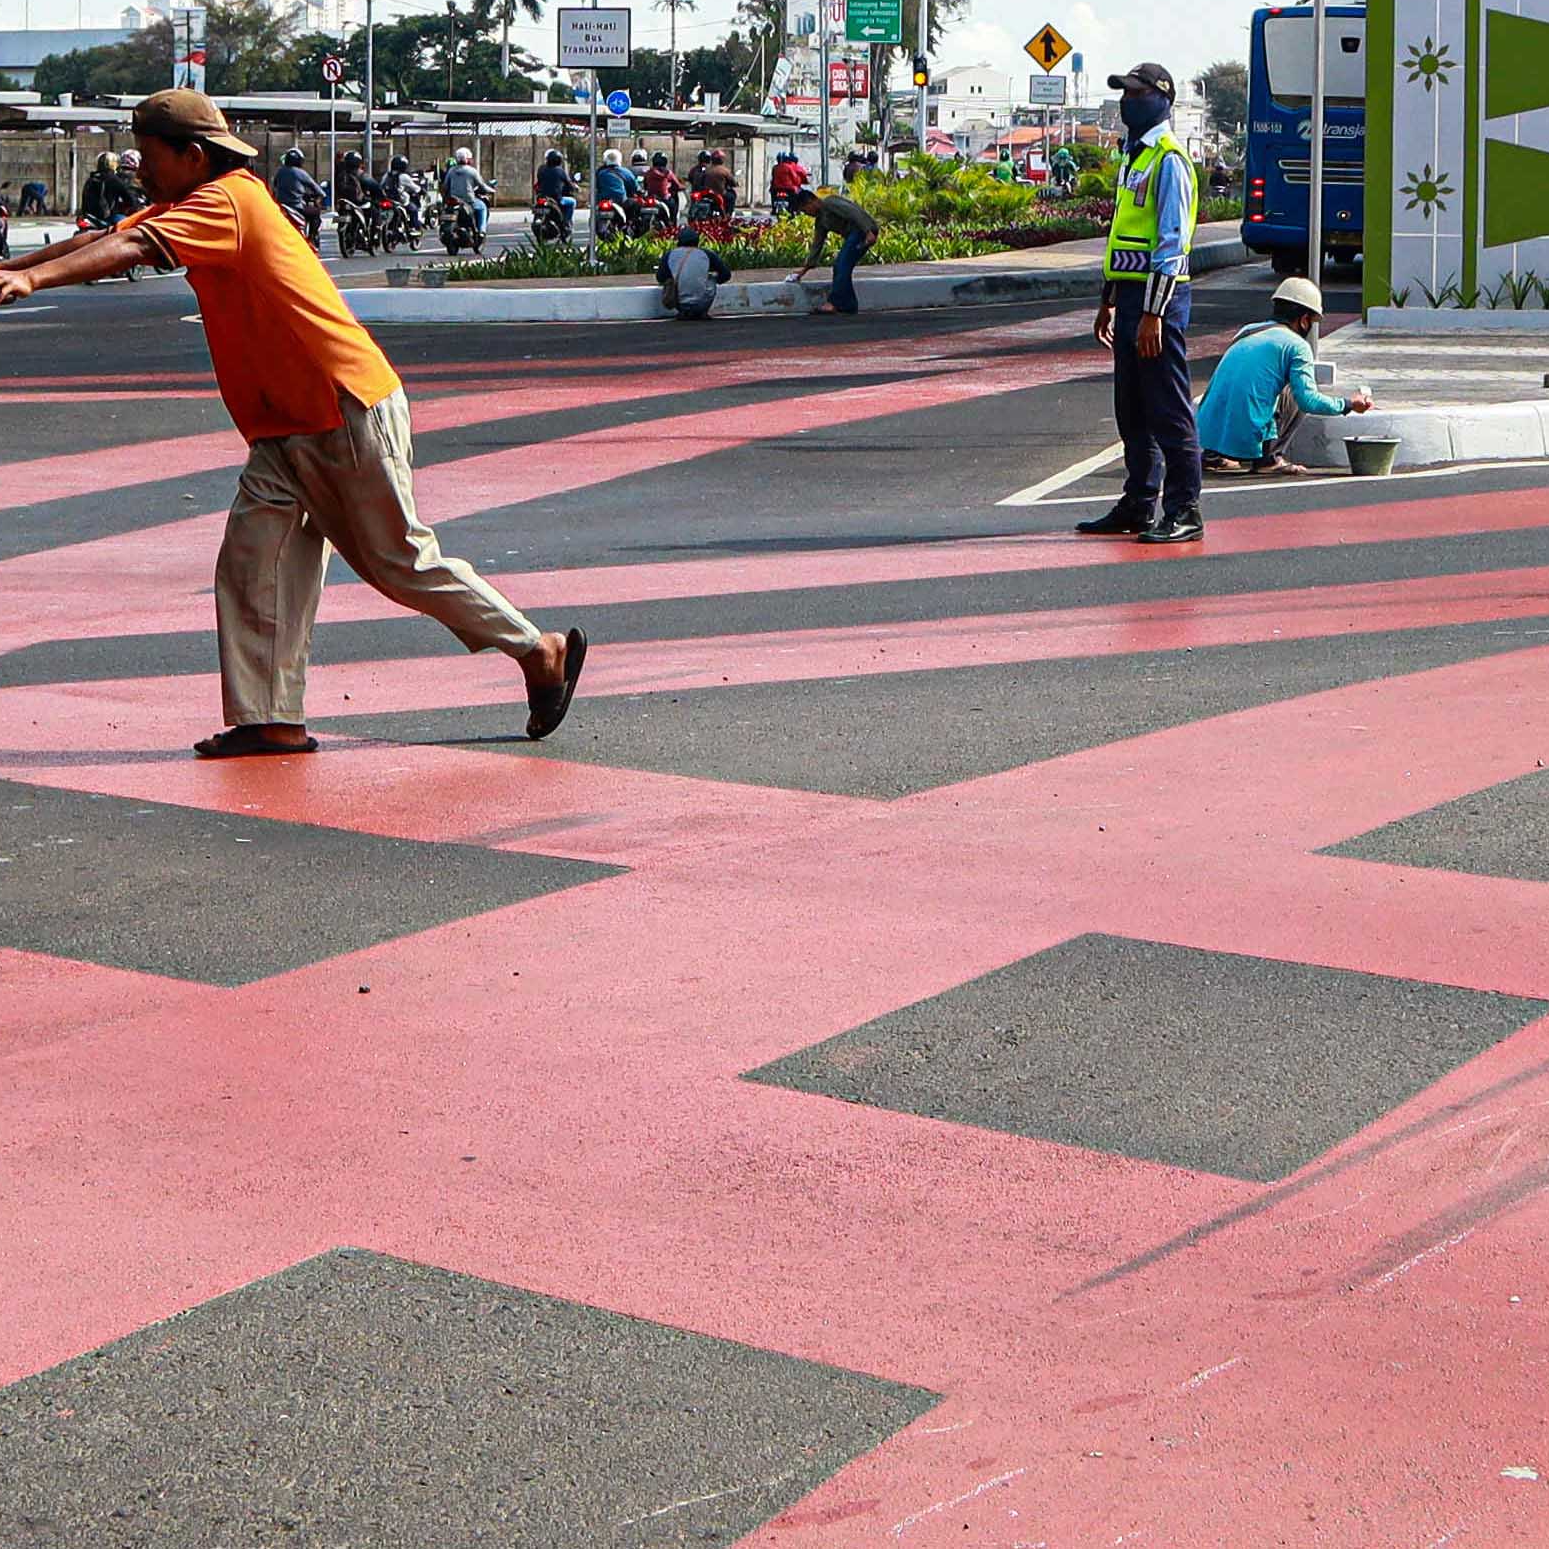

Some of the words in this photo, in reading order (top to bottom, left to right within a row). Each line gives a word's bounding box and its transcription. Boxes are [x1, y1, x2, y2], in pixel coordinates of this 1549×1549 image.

[571, 21, 617, 31] Hati-Hati
[584, 33, 603, 43] Bus
[562, 44, 626, 56] Transjakarta
[1322, 121, 1366, 139] transja
